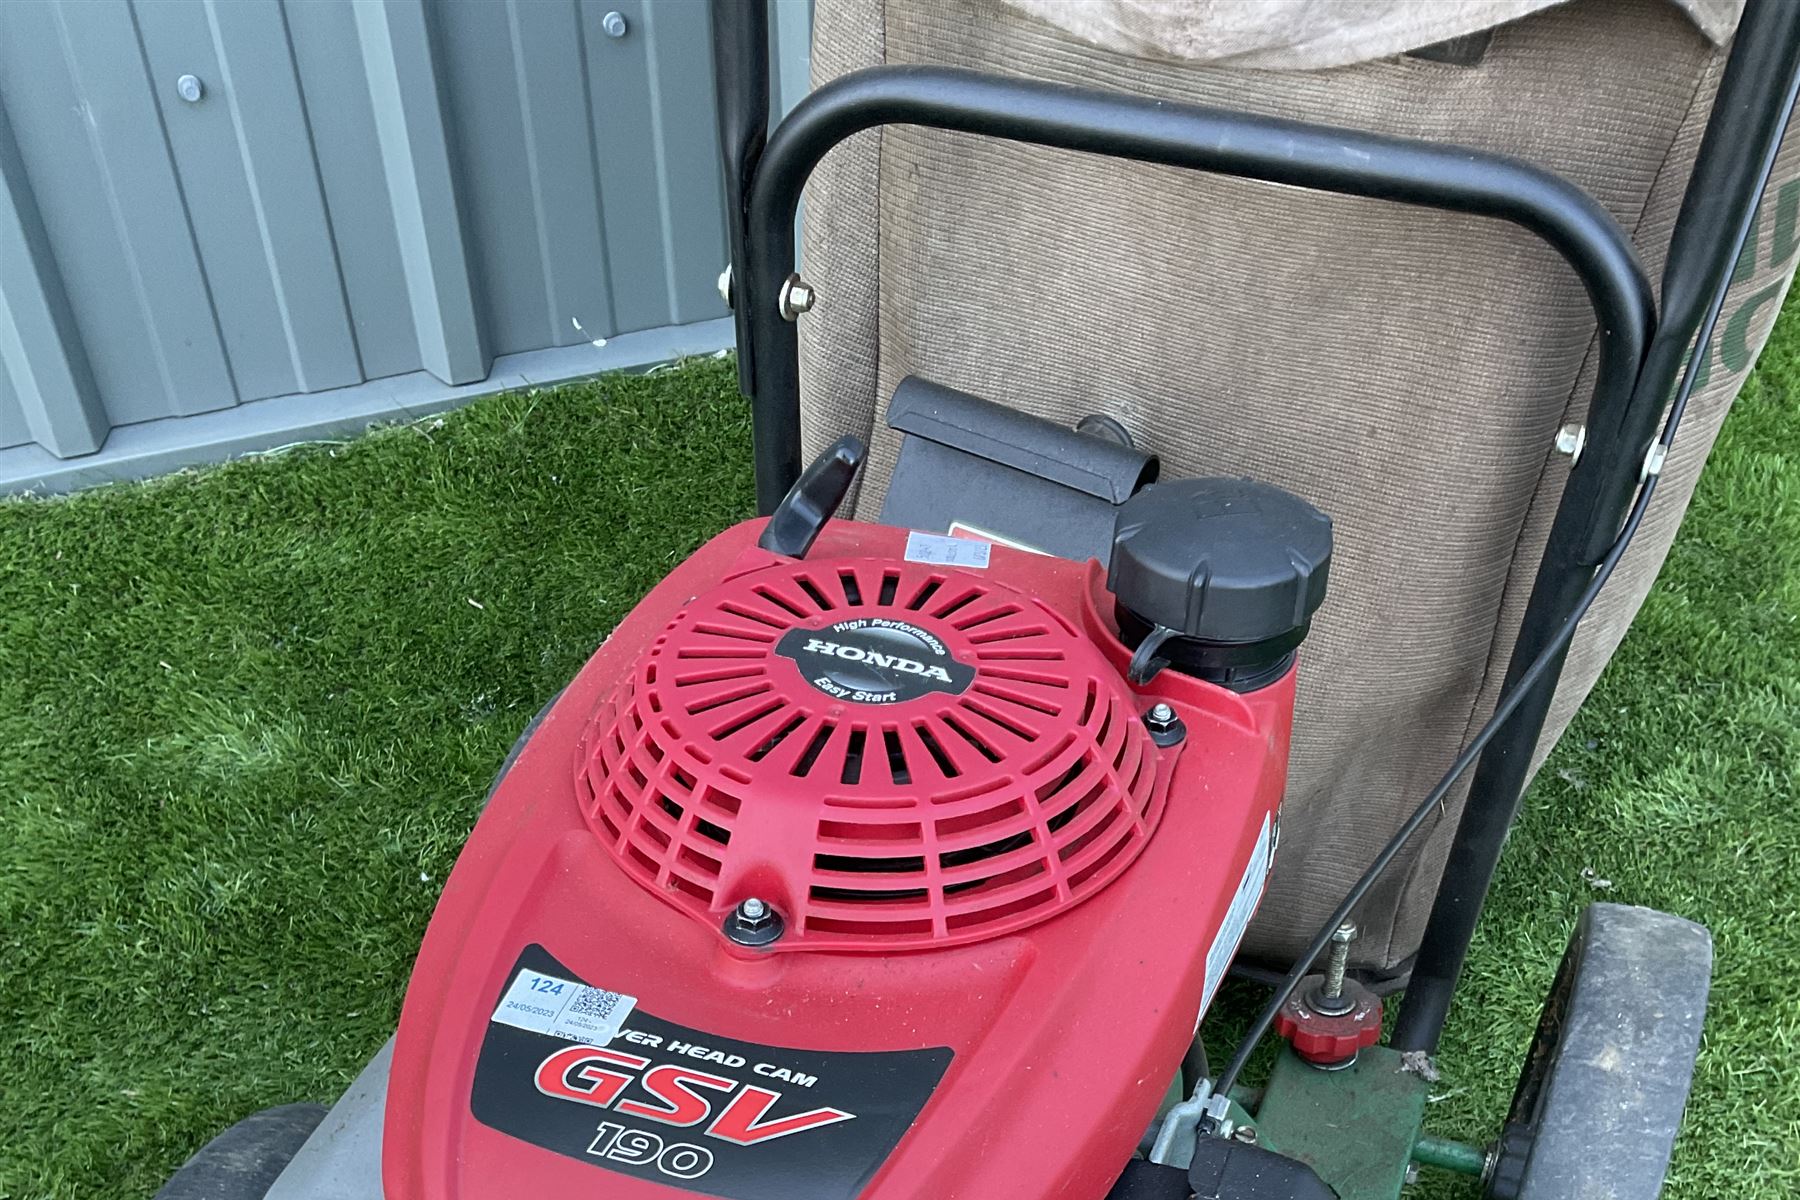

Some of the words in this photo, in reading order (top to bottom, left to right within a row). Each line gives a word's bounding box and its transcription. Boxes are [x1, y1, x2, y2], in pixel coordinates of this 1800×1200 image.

[833, 618, 867, 634] High
[871, 618, 946, 657] Performance
[803, 637, 953, 683] HONDA
[814, 676, 851, 699] Easy
[852, 691, 897, 703] Start
[531, 977, 565, 996] 124
[506, 1001, 555, 1018] 24/05/2023
[613, 1028, 663, 1048] VER
[667, 1040, 746, 1069] HEAD
[753, 1061, 818, 1088] CAM
[534, 1045, 857, 1146] GSV
[587, 1122, 714, 1179] 190
